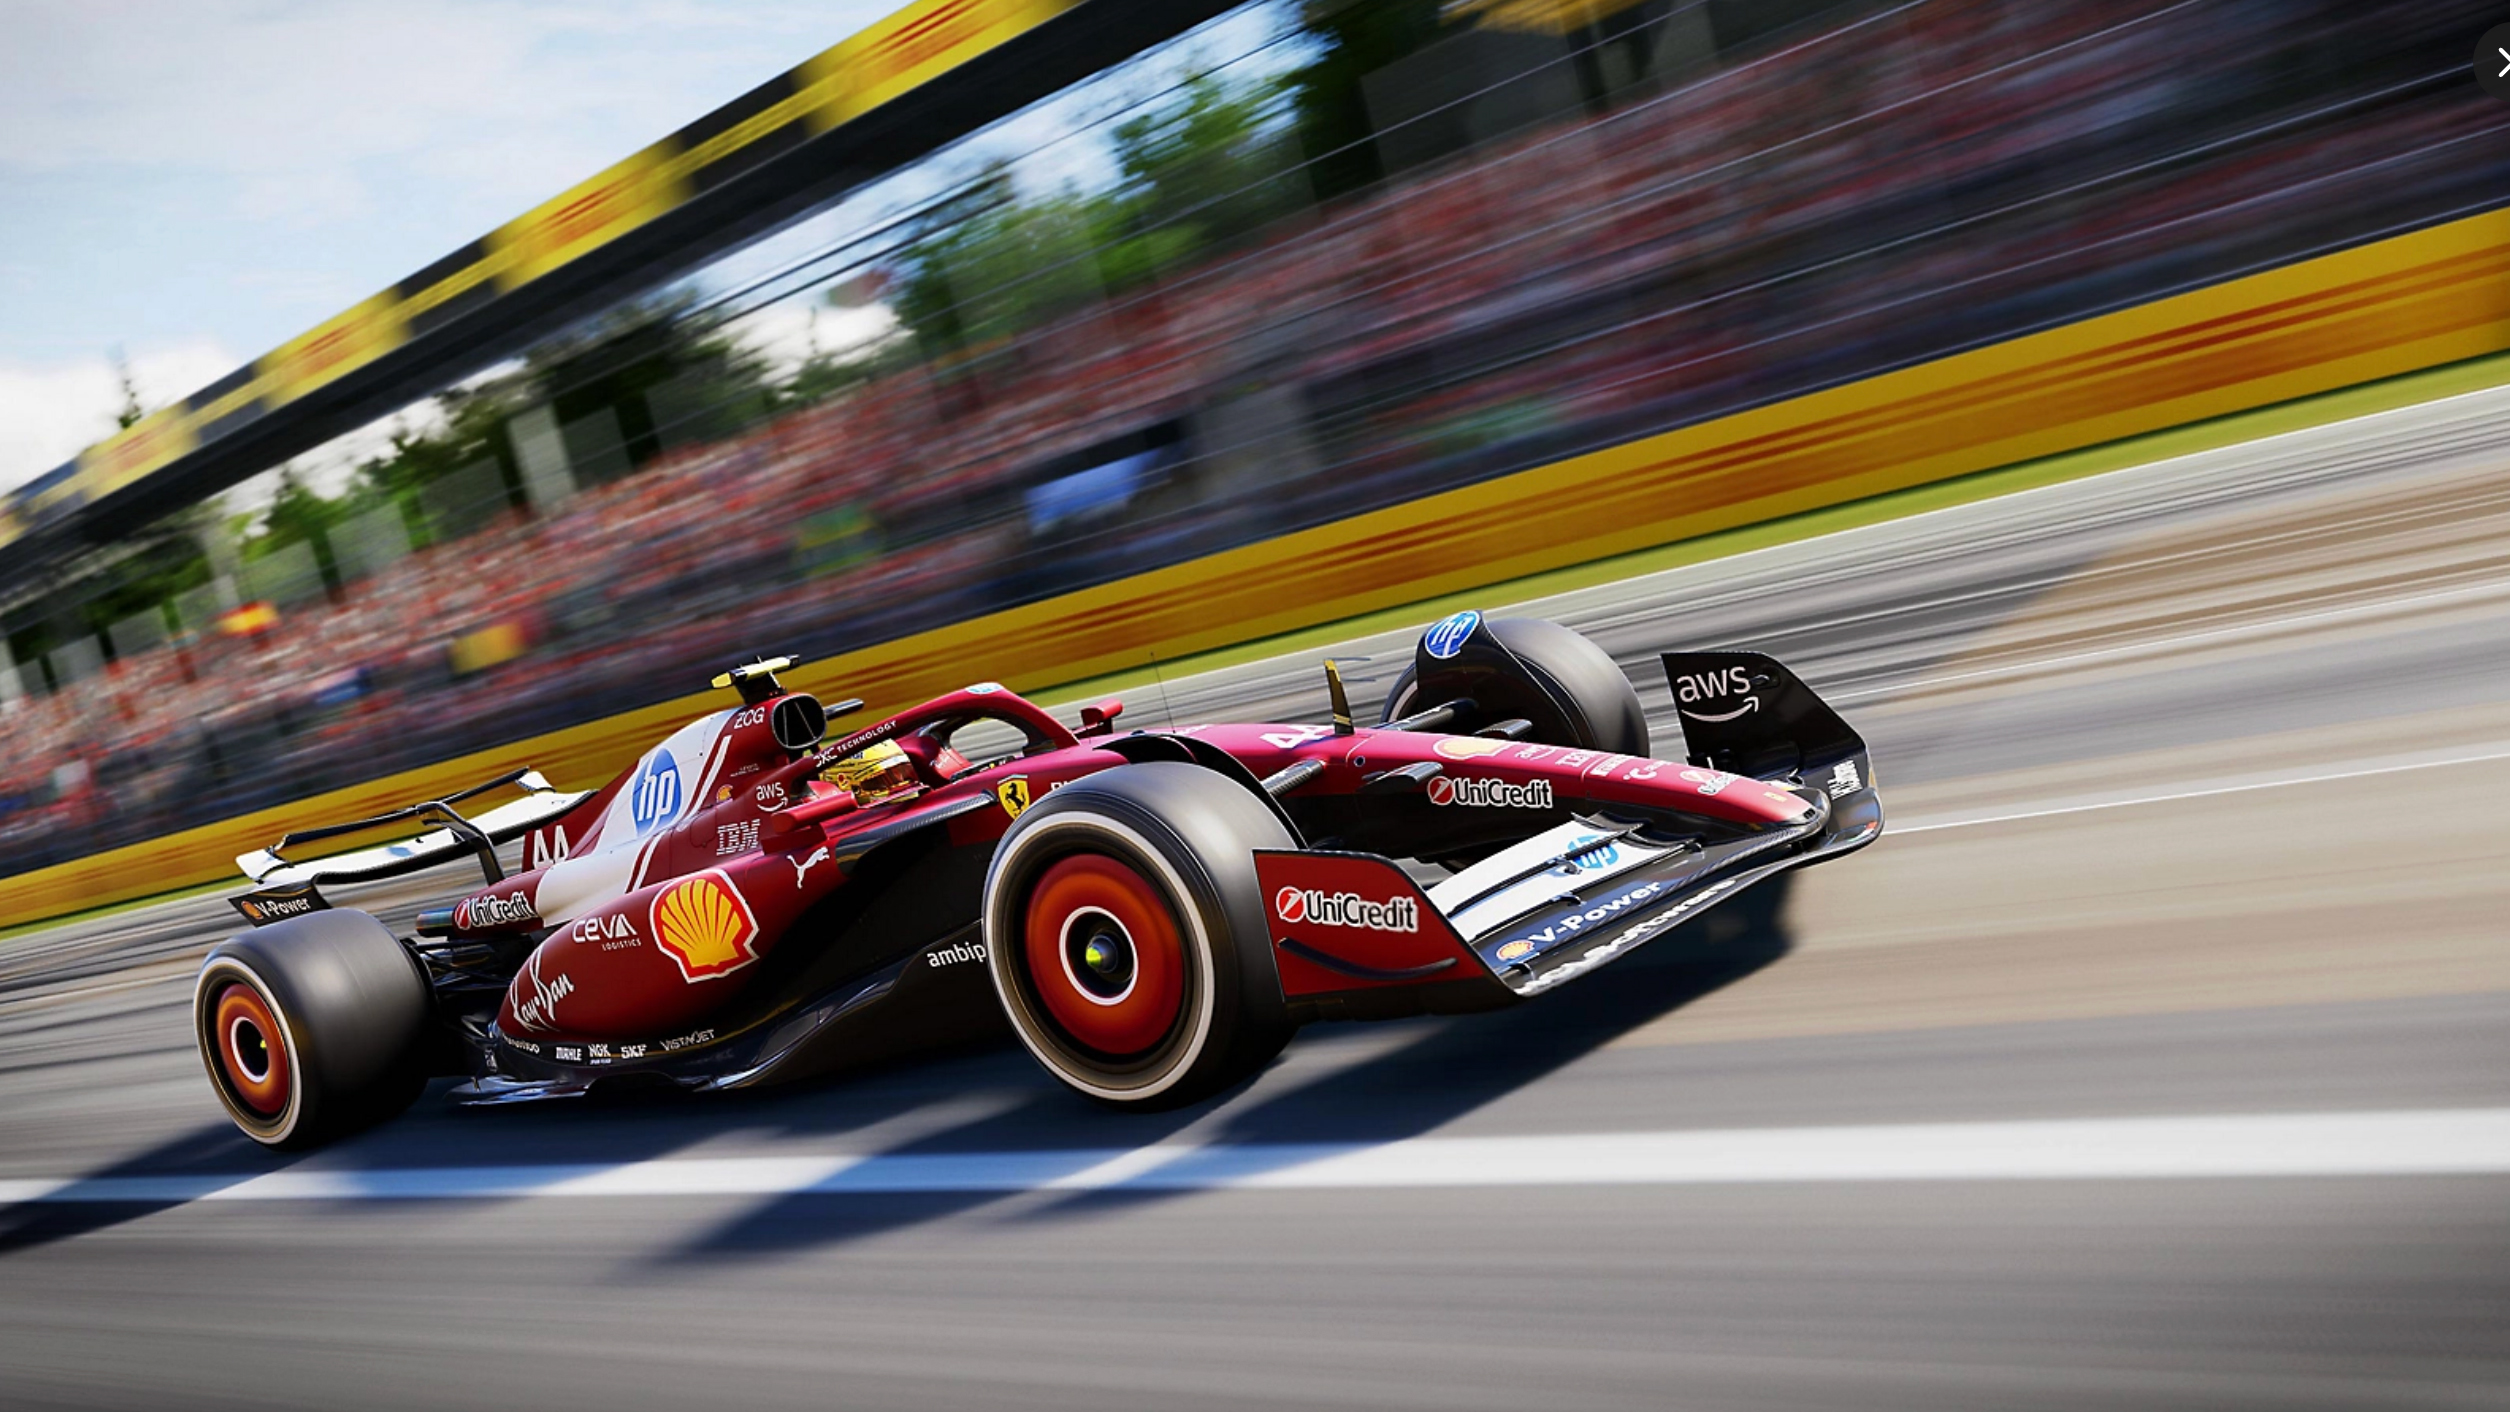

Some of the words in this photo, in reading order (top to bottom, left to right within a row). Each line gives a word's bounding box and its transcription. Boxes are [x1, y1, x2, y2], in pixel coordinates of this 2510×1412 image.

[1430, 613, 1476, 655] hp
[1676, 665, 1751, 702] aws
[836, 720, 897, 754] TECHNOLOGY
[637, 762, 676, 828] hp
[755, 782, 785, 801] aws
[1453, 778, 1553, 808] UniCredit
[532, 824, 569, 870] 44
[716, 818, 761, 857] IBM
[253, 897, 311, 917] V-Power
[468, 890, 537, 927] UniCredit
[1303, 888, 1418, 932] UniCredit
[1529, 881, 1661, 944] V-Power
[601, 938, 642, 951] LOGISTICS
[588, 1044, 611, 1058] NGK
[620, 1044, 647, 1059] SKF
